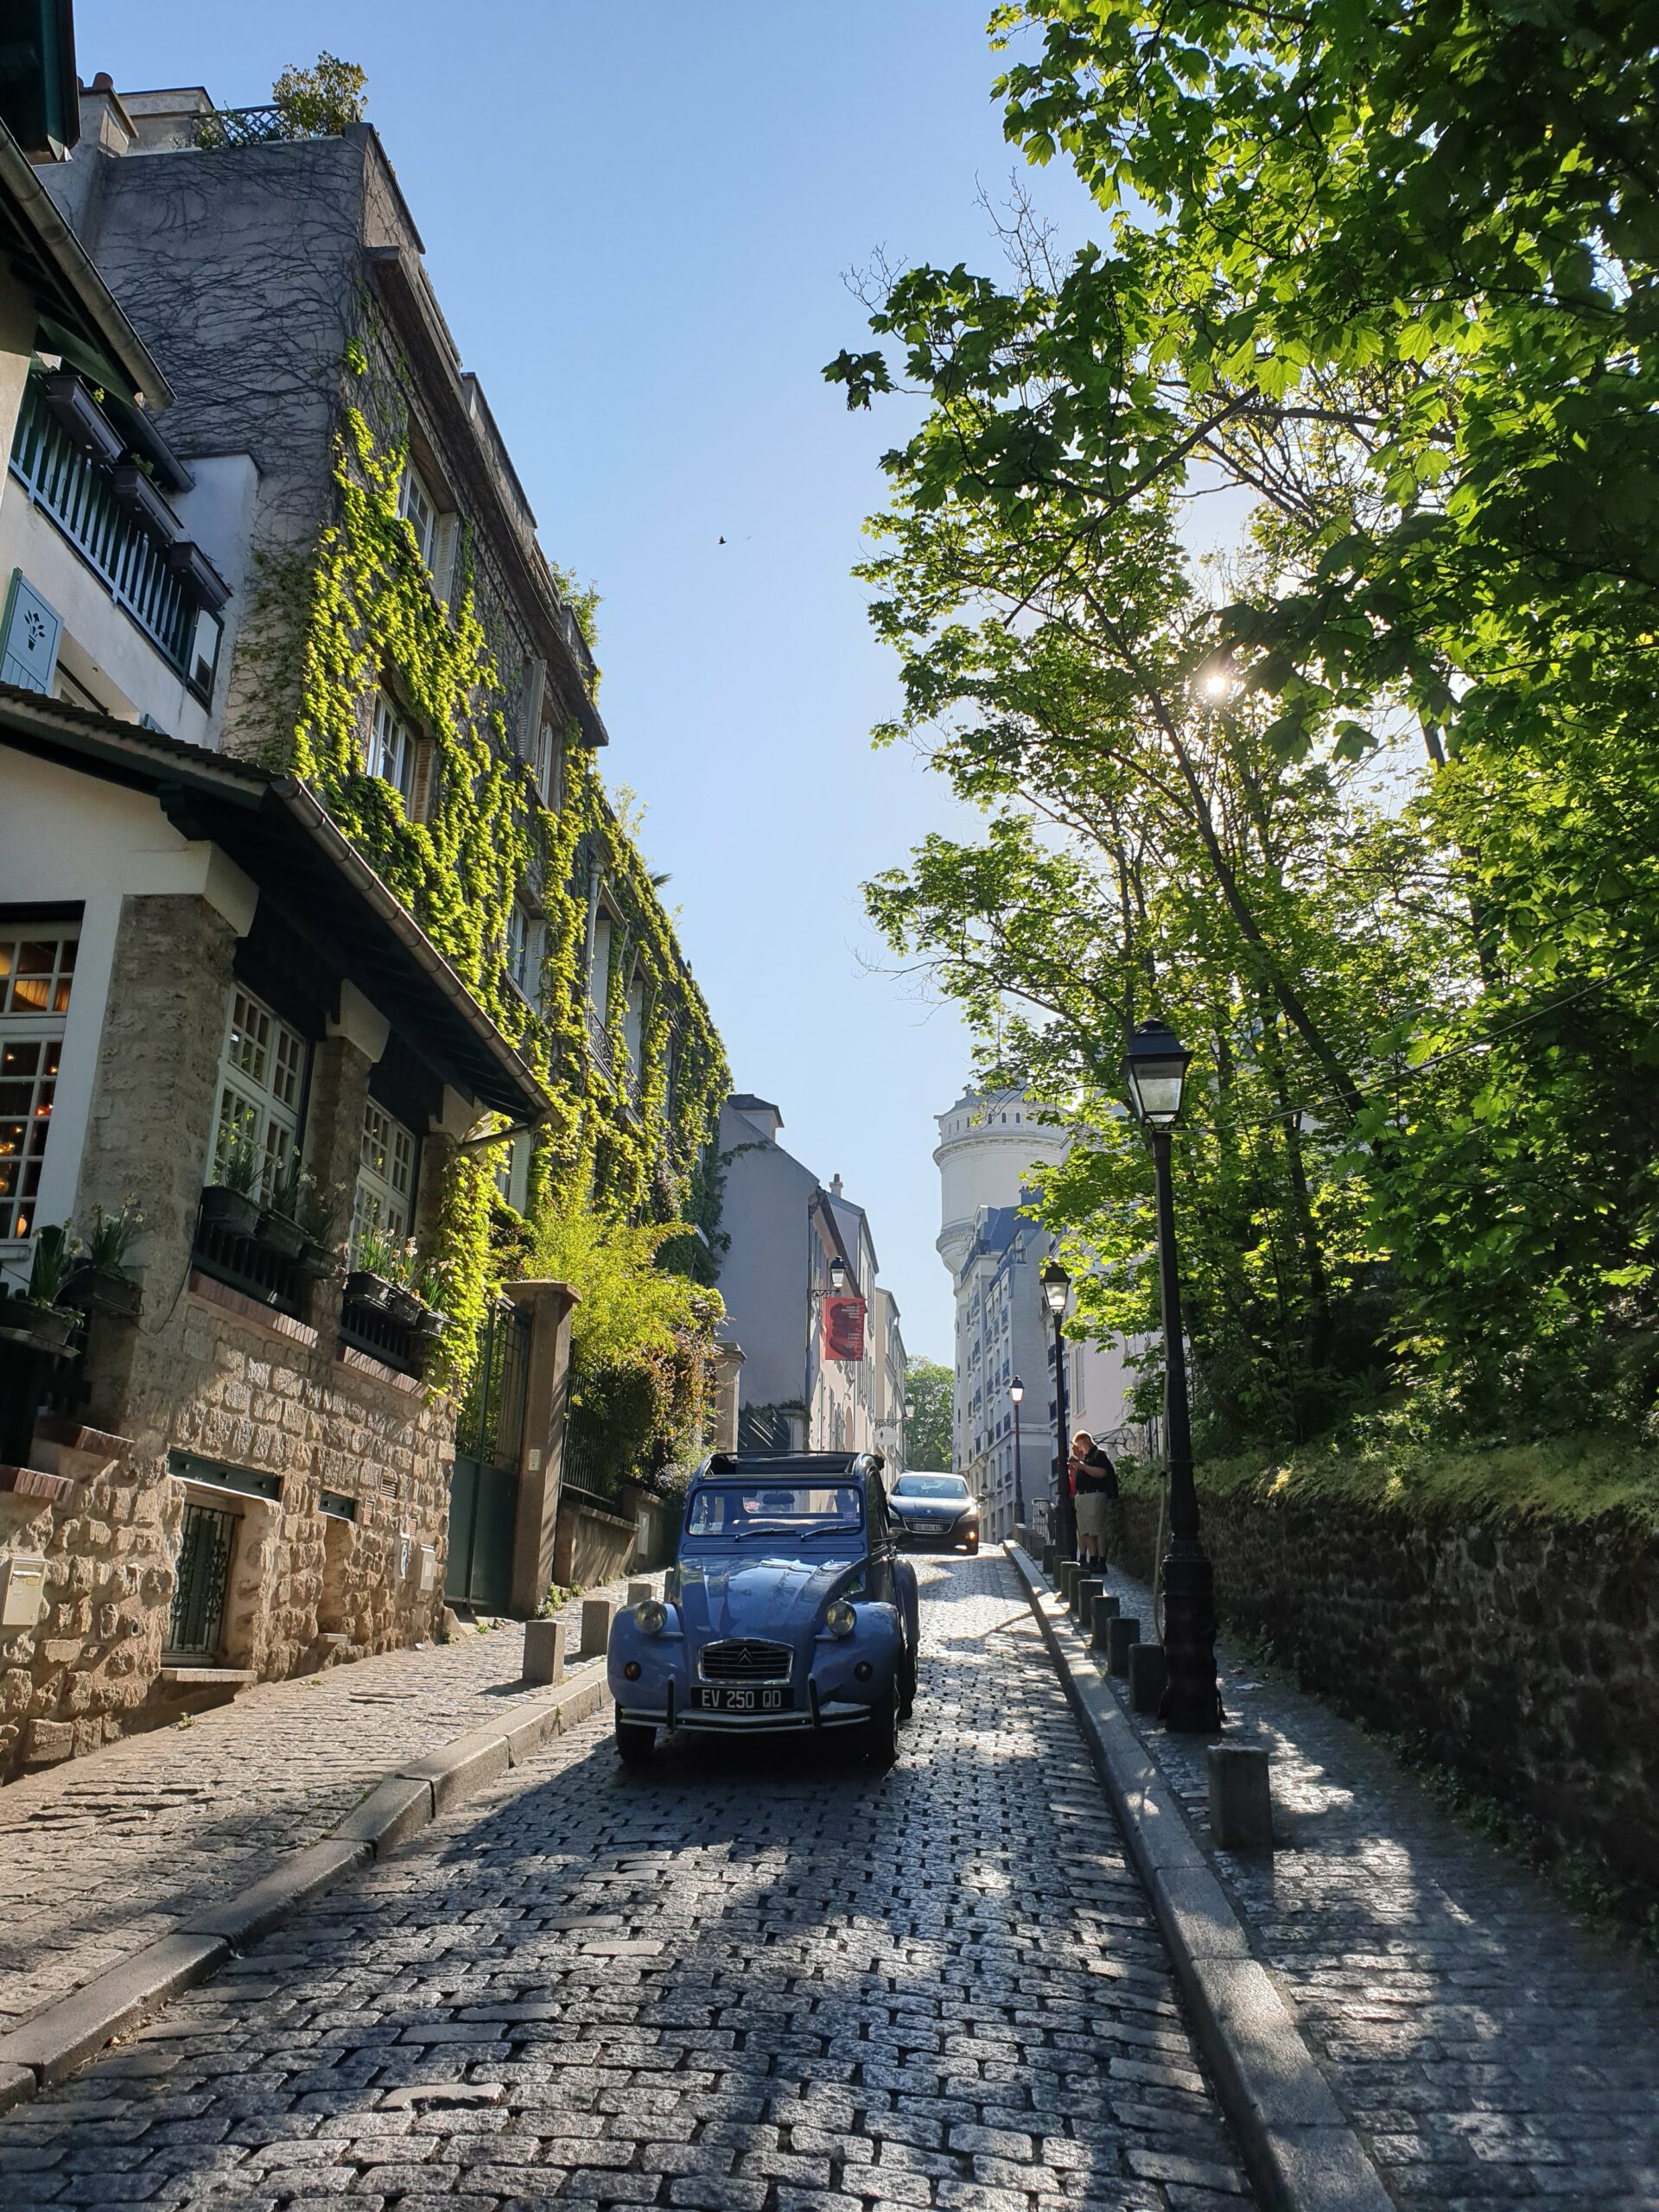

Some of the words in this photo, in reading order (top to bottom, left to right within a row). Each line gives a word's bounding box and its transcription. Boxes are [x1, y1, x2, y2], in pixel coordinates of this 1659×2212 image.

[702, 1689, 720, 1707] EV
[727, 1691, 755, 1708] 250
[763, 1690, 782, 1707] QD
